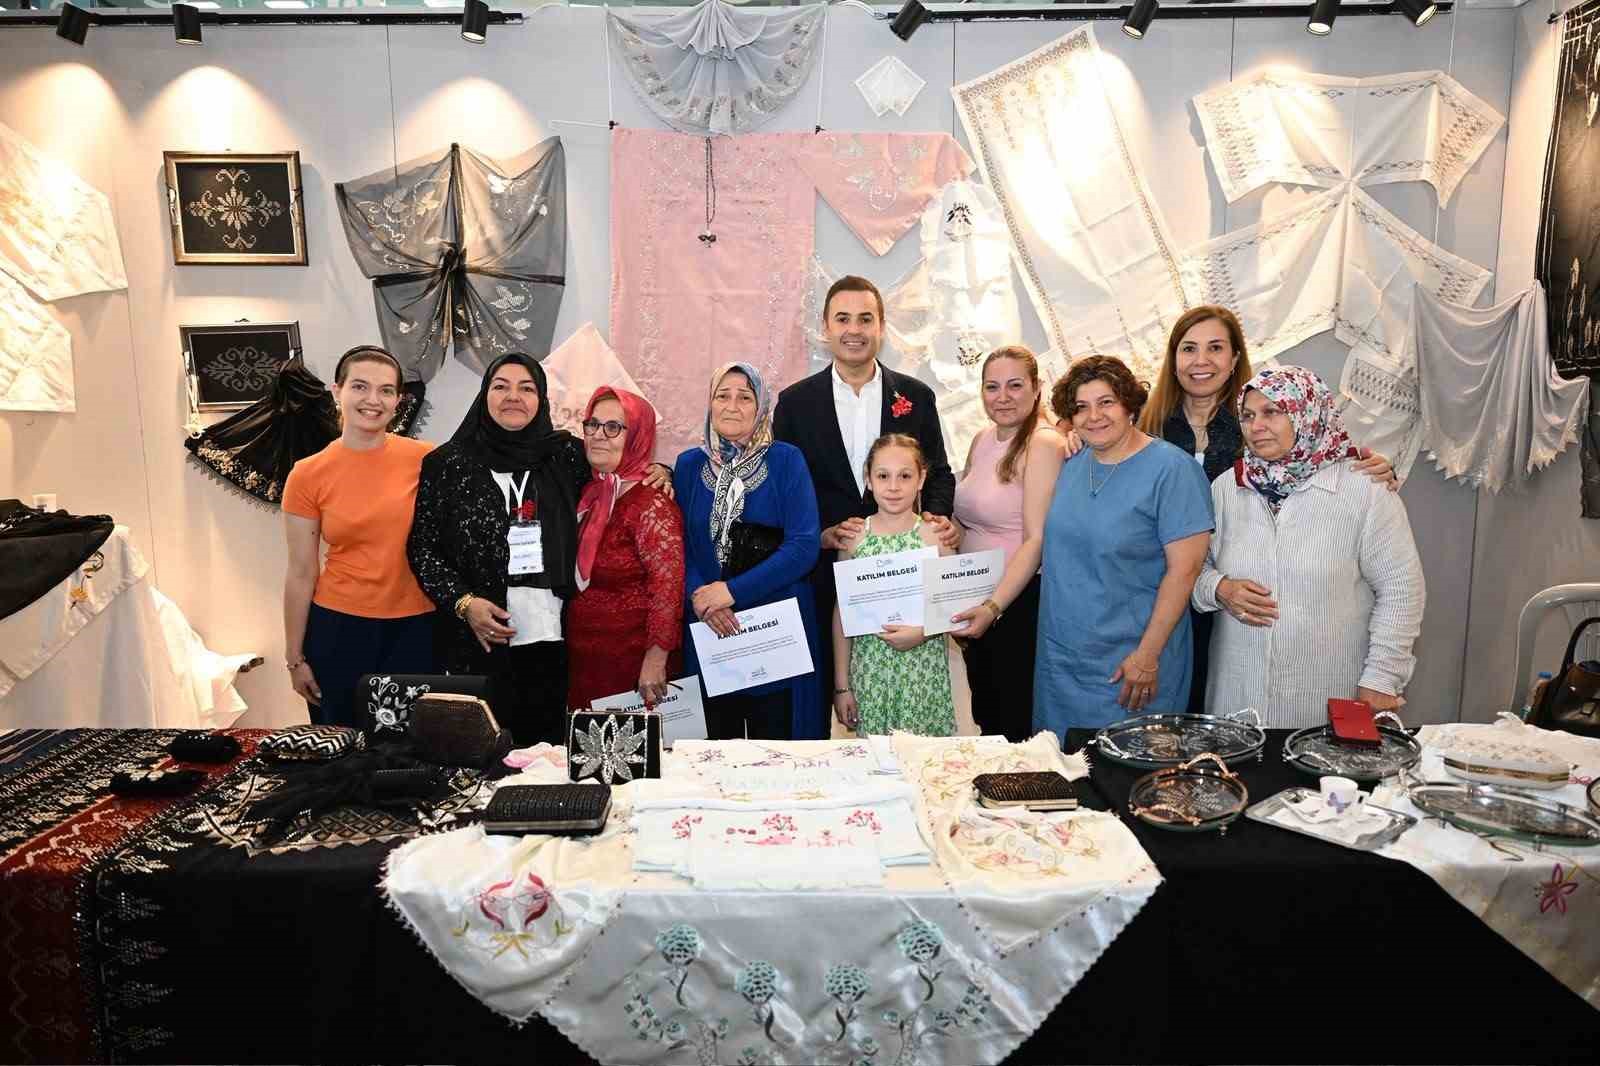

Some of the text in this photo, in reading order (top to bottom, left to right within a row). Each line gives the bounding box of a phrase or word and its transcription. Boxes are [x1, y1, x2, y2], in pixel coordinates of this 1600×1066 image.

[856, 564, 917, 581] KATILIM BELGESİ
[941, 564, 990, 580] KATILIM BELGESİ
[748, 618, 778, 633] BELGESİ
